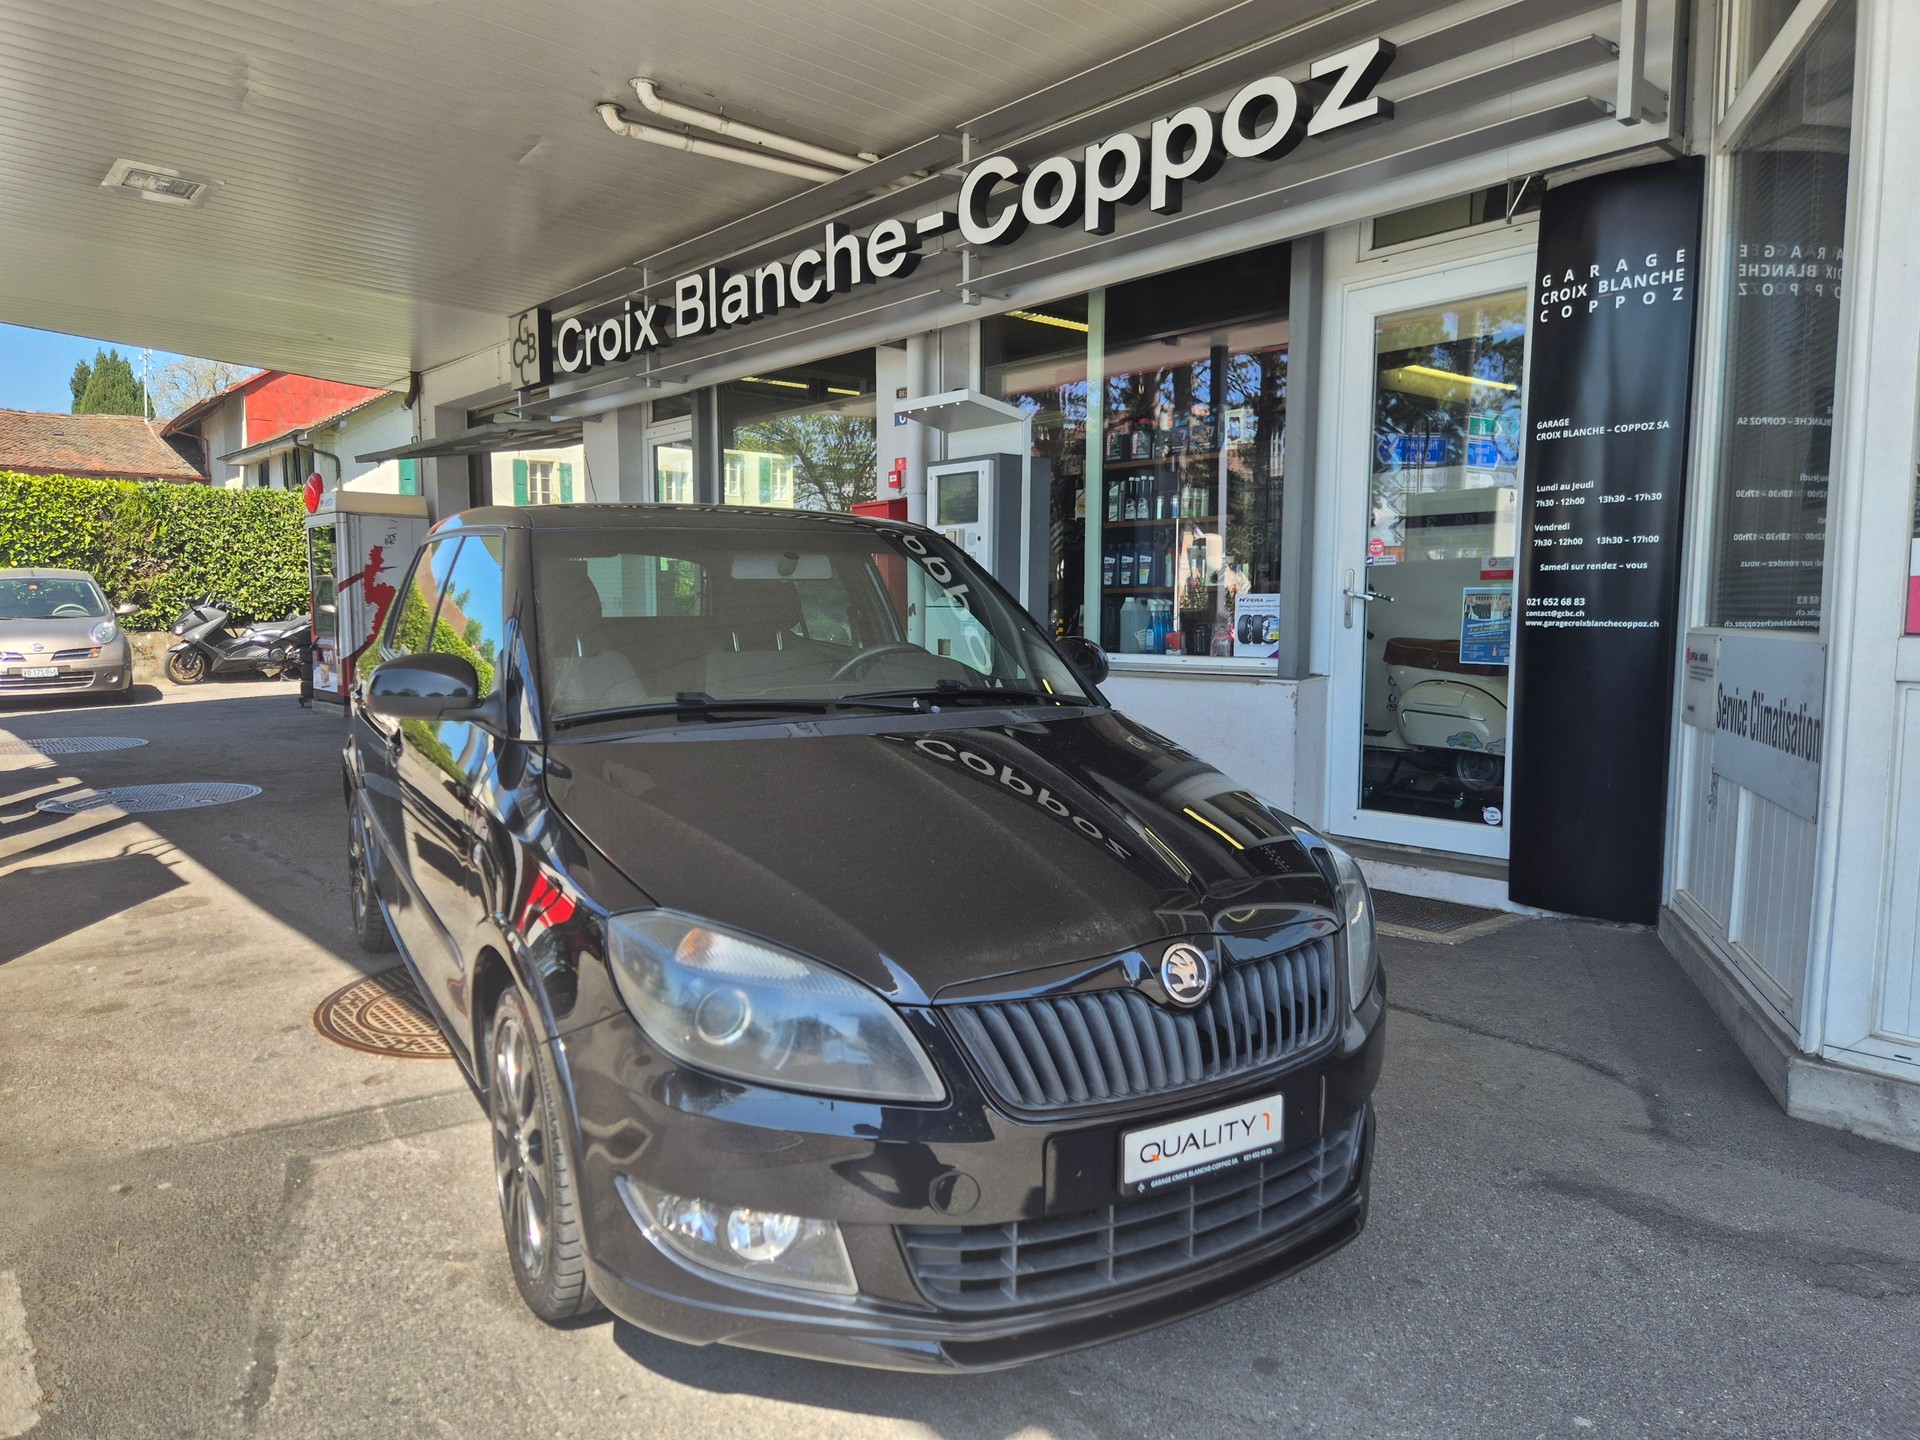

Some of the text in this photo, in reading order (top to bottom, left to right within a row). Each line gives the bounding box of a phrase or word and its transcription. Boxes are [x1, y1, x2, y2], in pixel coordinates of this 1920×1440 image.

[1542, 248, 1686, 288] GARAGE
[1540, 267, 1686, 306] CROIX BLANCHE
[1539, 286, 1684, 323] COPPOZ
[556, 300, 660, 373] Croix
[1536, 417, 1570, 430] GARAGE
[1536, 429, 1561, 441] CROIX
[1562, 426, 1605, 439] BLANCHE
[1613, 421, 1655, 434] COPPOZ
[1656, 420, 1670, 430] SA
[1536, 483, 1559, 493] Lundi
[1559, 483, 1571, 491] au
[1535, 498, 1554, 508] 7h30
[1560, 497, 1585, 506] 12h00
[1598, 494, 1625, 504] 13h30
[1634, 492, 1663, 502] 17h30
[1534, 522, 1570, 532] Vendredi
[1533, 539, 1552, 547] 7h30
[1558, 537, 1583, 546] 12h00
[1596, 536, 1623, 545] 13h30
[1632, 535, 1660, 544] 17h00
[1539, 562, 1569, 571] Samedi
[1570, 563, 1585, 571] sur
[1586, 562, 1617, 570] rendez
[1625, 561, 1648, 569] vous
[1526, 597, 1586, 606] 021 652 68 83
[1525, 609, 1585, 619] contact@gcbc.ch
[1525, 618, 1660, 629] www.garagecroixblanchecoppoz.ch
[1716, 682, 1821, 764] Service Climatisation
